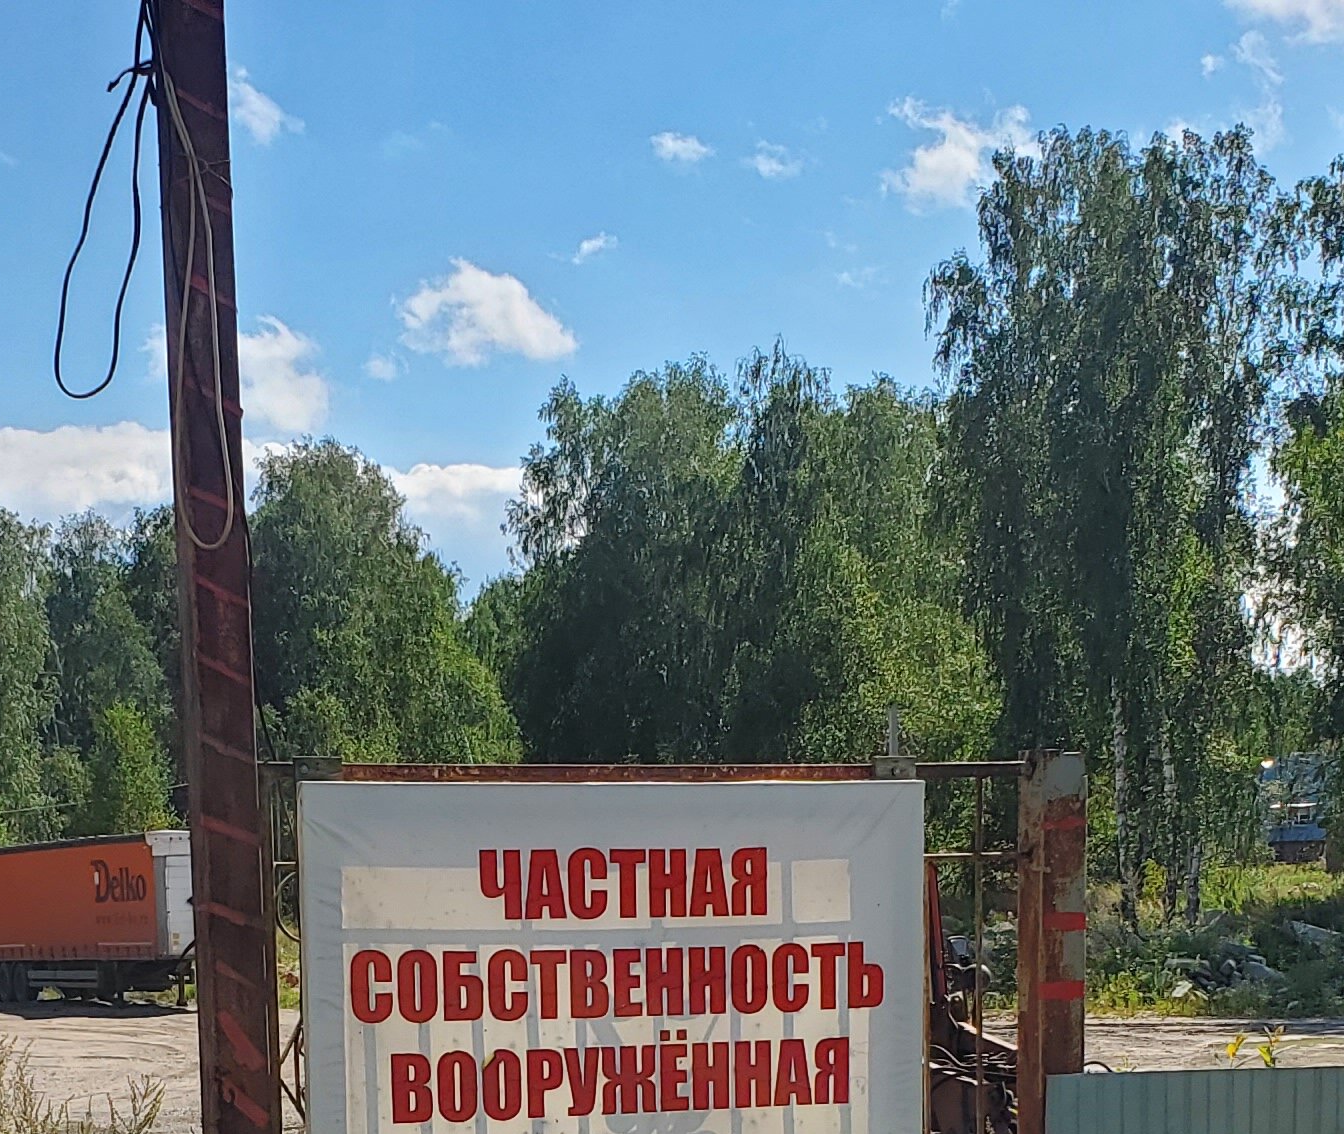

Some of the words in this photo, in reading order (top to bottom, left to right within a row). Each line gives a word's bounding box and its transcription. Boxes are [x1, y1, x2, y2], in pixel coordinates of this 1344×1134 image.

[90, 859, 147, 903] Delko
[479, 847, 768, 921] ЧАСТНАЯ
[349, 941, 885, 1024] СОБСТВЕННОСТЬ
[390, 1029, 850, 1125] ВООРУЖЁННАЯ
